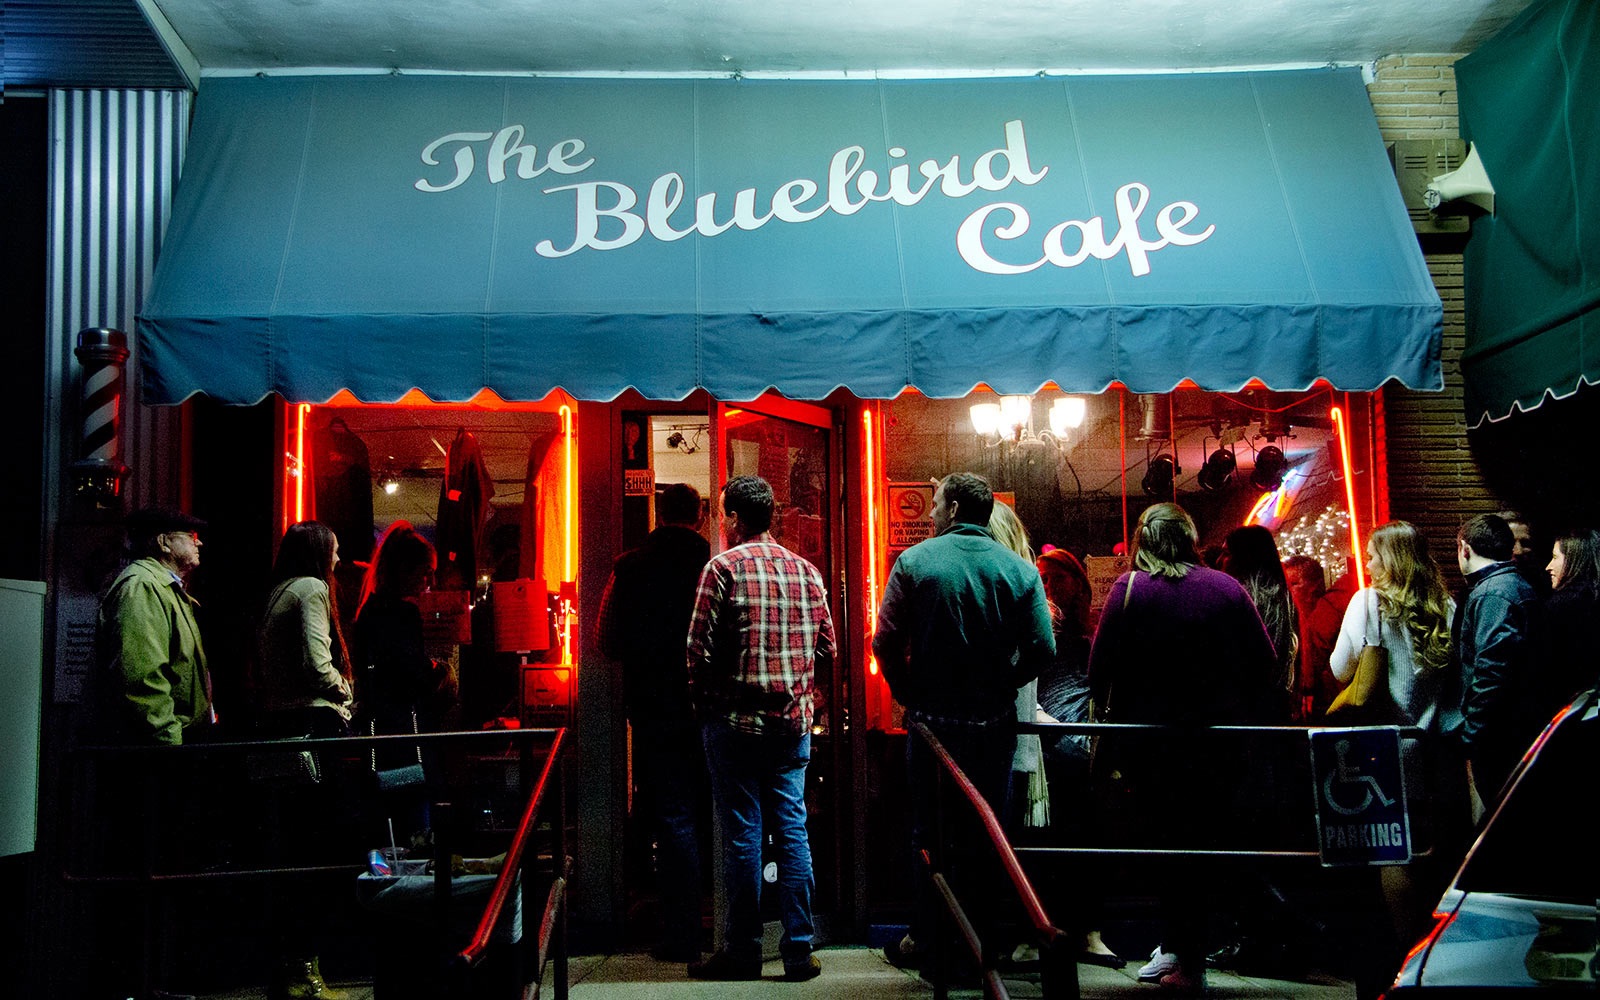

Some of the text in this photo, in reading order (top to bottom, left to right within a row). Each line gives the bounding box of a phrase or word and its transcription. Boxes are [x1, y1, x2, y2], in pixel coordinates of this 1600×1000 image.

[414, 123, 596, 193] The
[535, 119, 1049, 259] Bluebird
[956, 182, 1217, 277] Cafe
[625, 476, 652, 489] SHHH
[1325, 822, 1403, 848] PARKING
